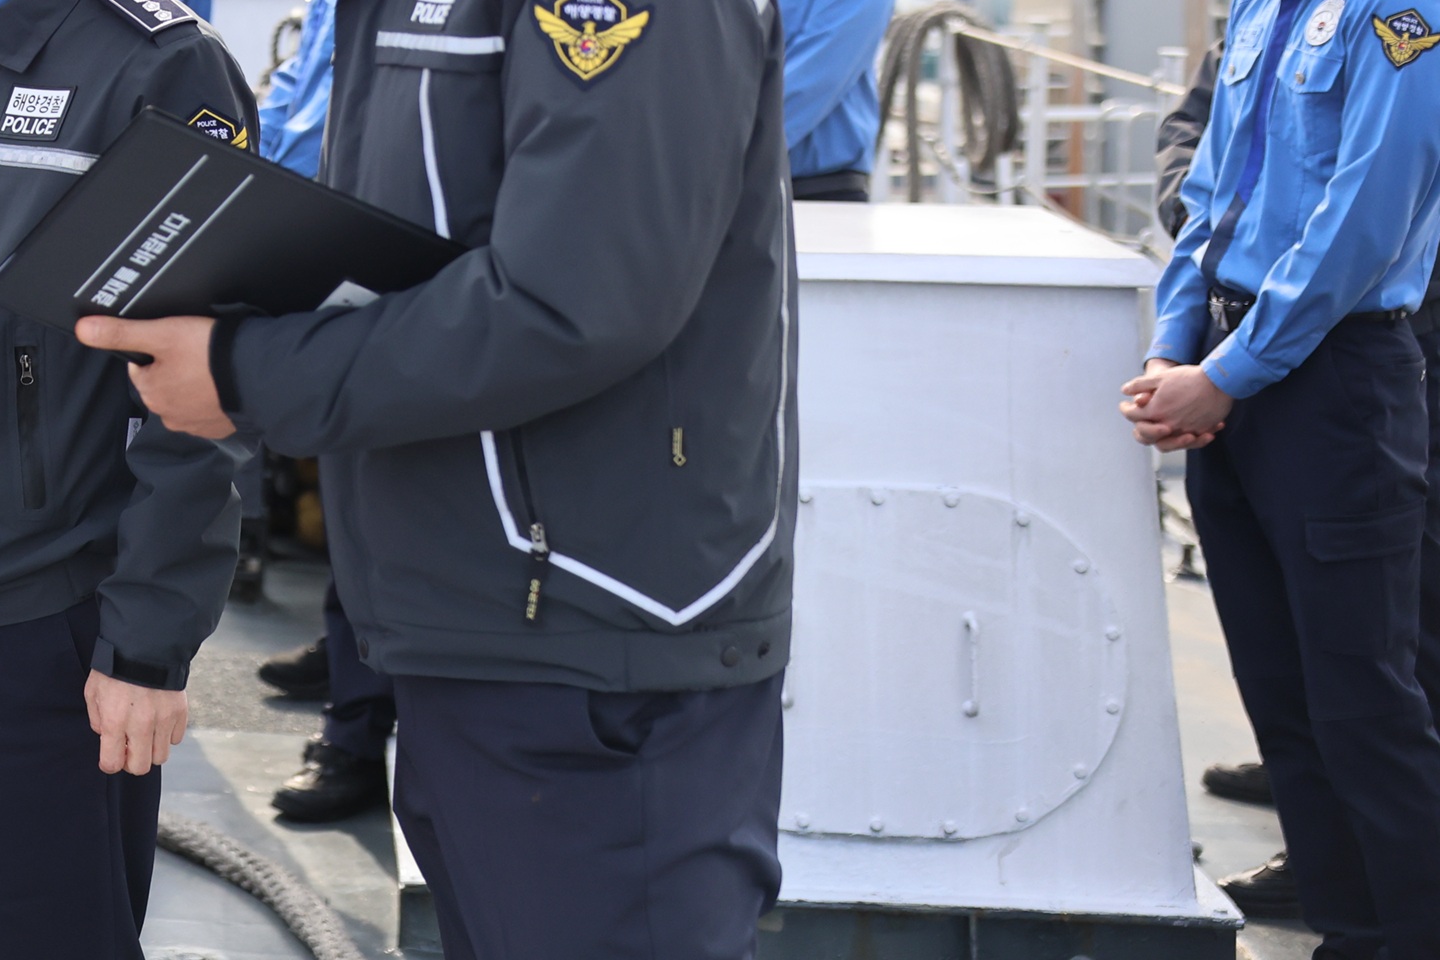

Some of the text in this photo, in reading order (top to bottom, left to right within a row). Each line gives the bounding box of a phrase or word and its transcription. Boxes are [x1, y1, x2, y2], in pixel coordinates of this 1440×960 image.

[410, 1, 452, 24] POLICE
[13, 93, 64, 114] 해양경찰
[1, 116, 57, 135] POLICE
[196, 119, 217, 129] POLICE
[129, 212, 192, 267] 바랍니다
